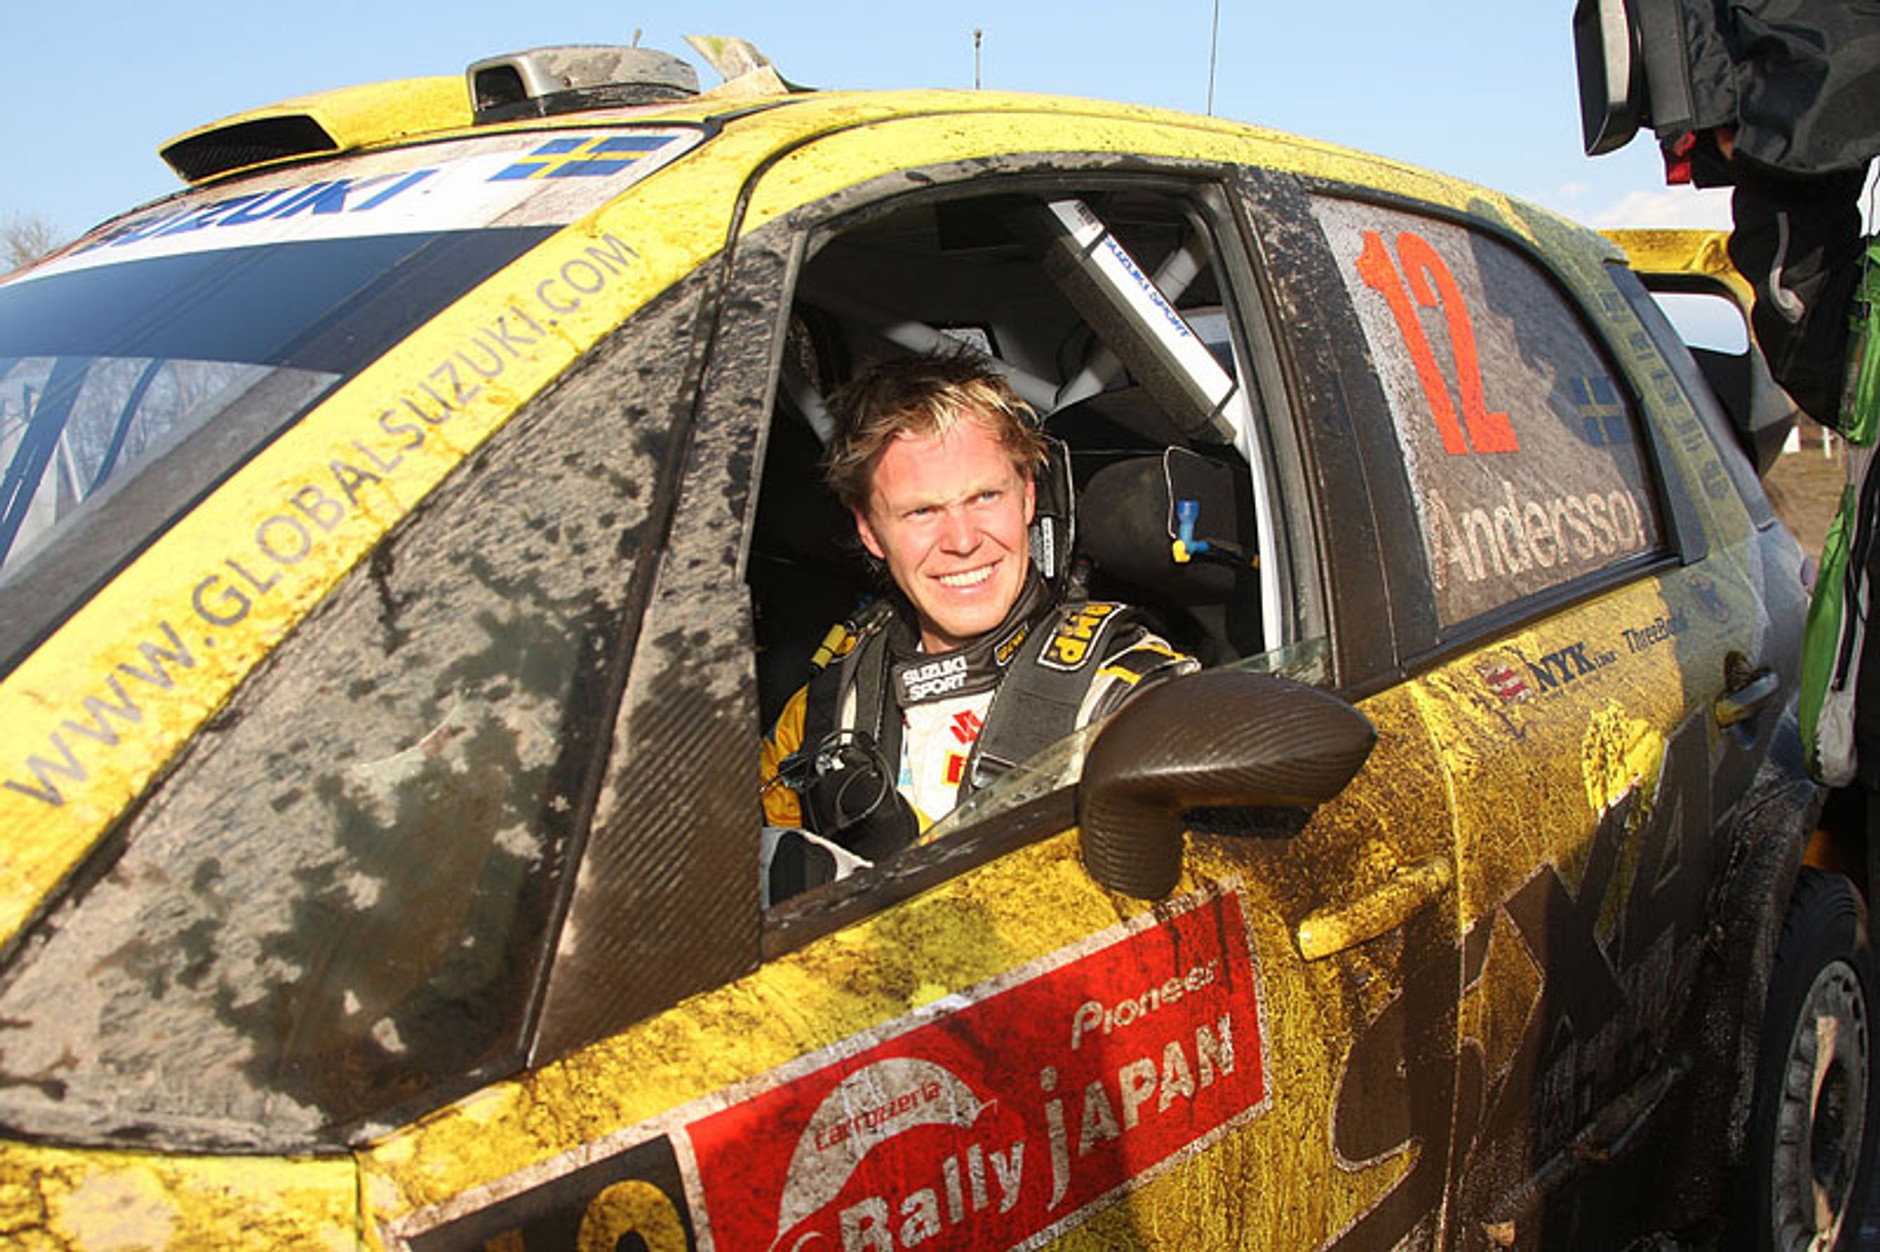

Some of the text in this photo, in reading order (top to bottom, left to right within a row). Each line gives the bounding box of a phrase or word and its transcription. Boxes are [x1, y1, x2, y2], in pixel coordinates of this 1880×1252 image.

[1354, 229, 1519, 456] 12
[4, 232, 642, 807] WWW.GLOBALSUZUKI.COM
[902, 655, 967, 687] SUZUKI
[908, 671, 967, 701] SPORT
[1527, 640, 1597, 693] NYK
[1071, 958, 1219, 1050] Pioneer
[814, 1079, 942, 1152] carrozzeria
[838, 1140, 1025, 1252] Rally
